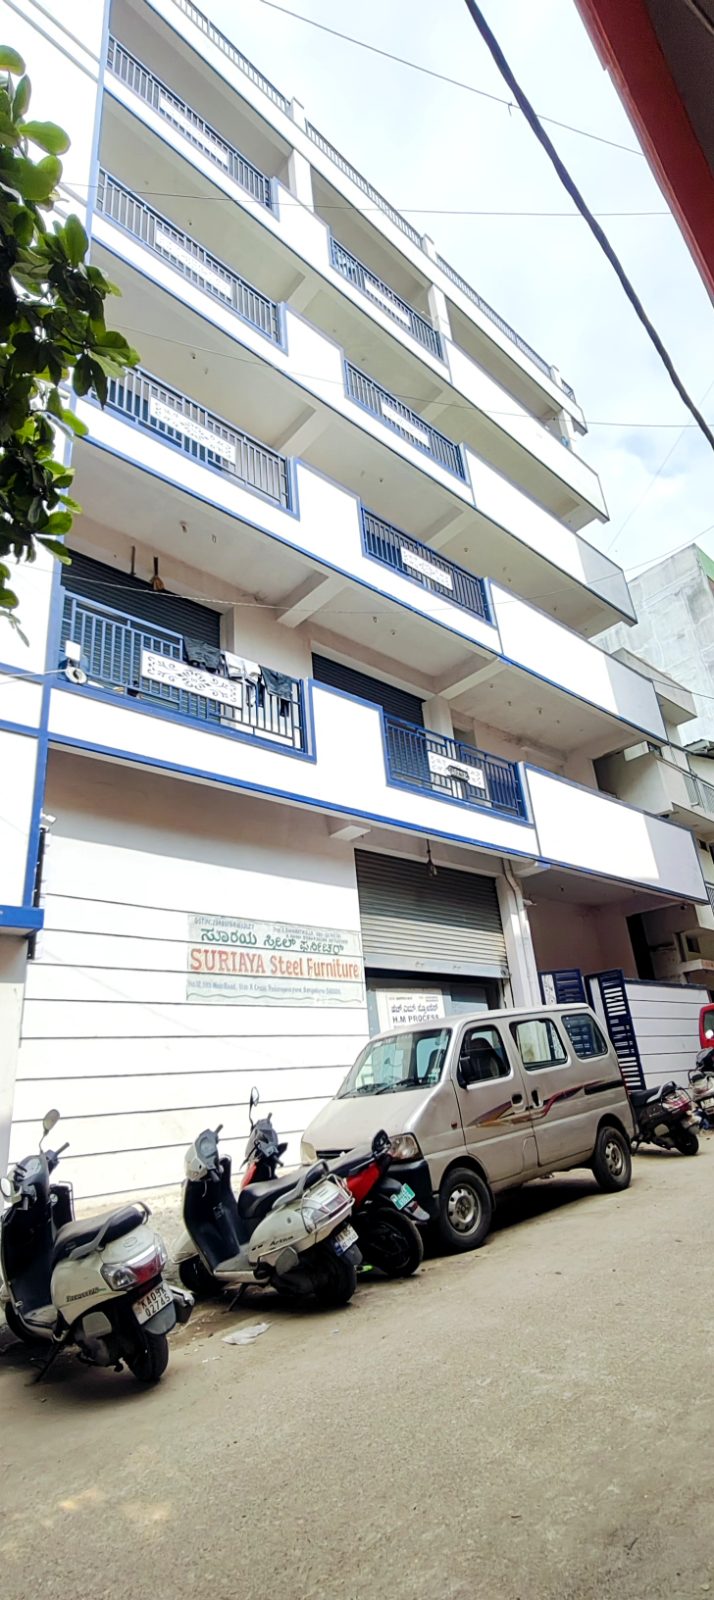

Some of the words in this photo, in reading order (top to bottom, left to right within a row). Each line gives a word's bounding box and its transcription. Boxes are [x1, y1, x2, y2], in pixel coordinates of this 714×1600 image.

[190, 948, 266, 974] SURIAYA
[270, 955, 304, 976] Steel
[306, 957, 360, 979] Furniture
